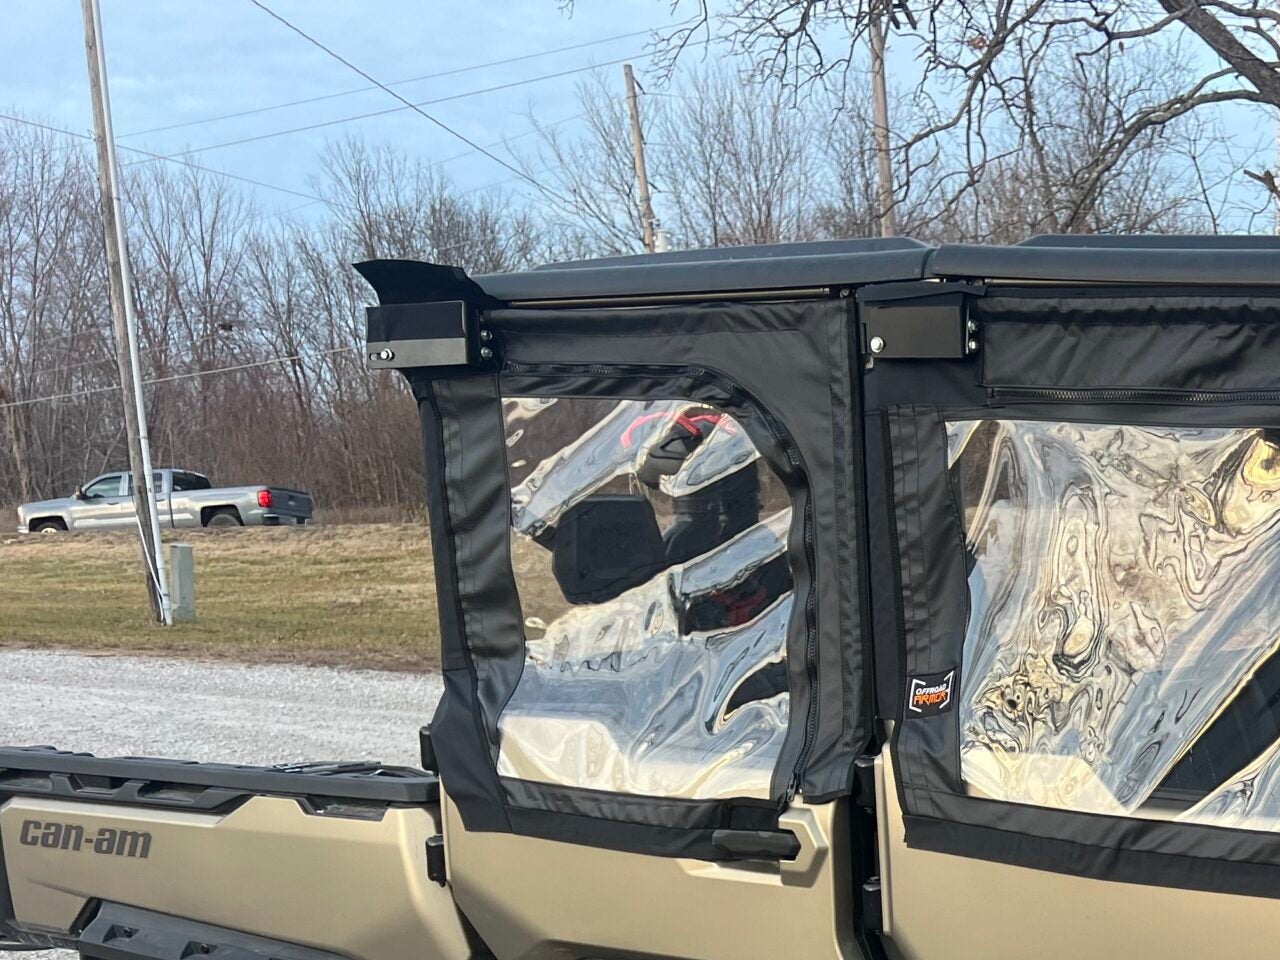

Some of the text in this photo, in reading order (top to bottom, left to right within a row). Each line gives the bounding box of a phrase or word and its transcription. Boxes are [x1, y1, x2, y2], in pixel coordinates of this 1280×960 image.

[915, 683, 947, 696] OFFROAD
[913, 691, 946, 706] ARMOR
[19, 819, 153, 859] can-am
